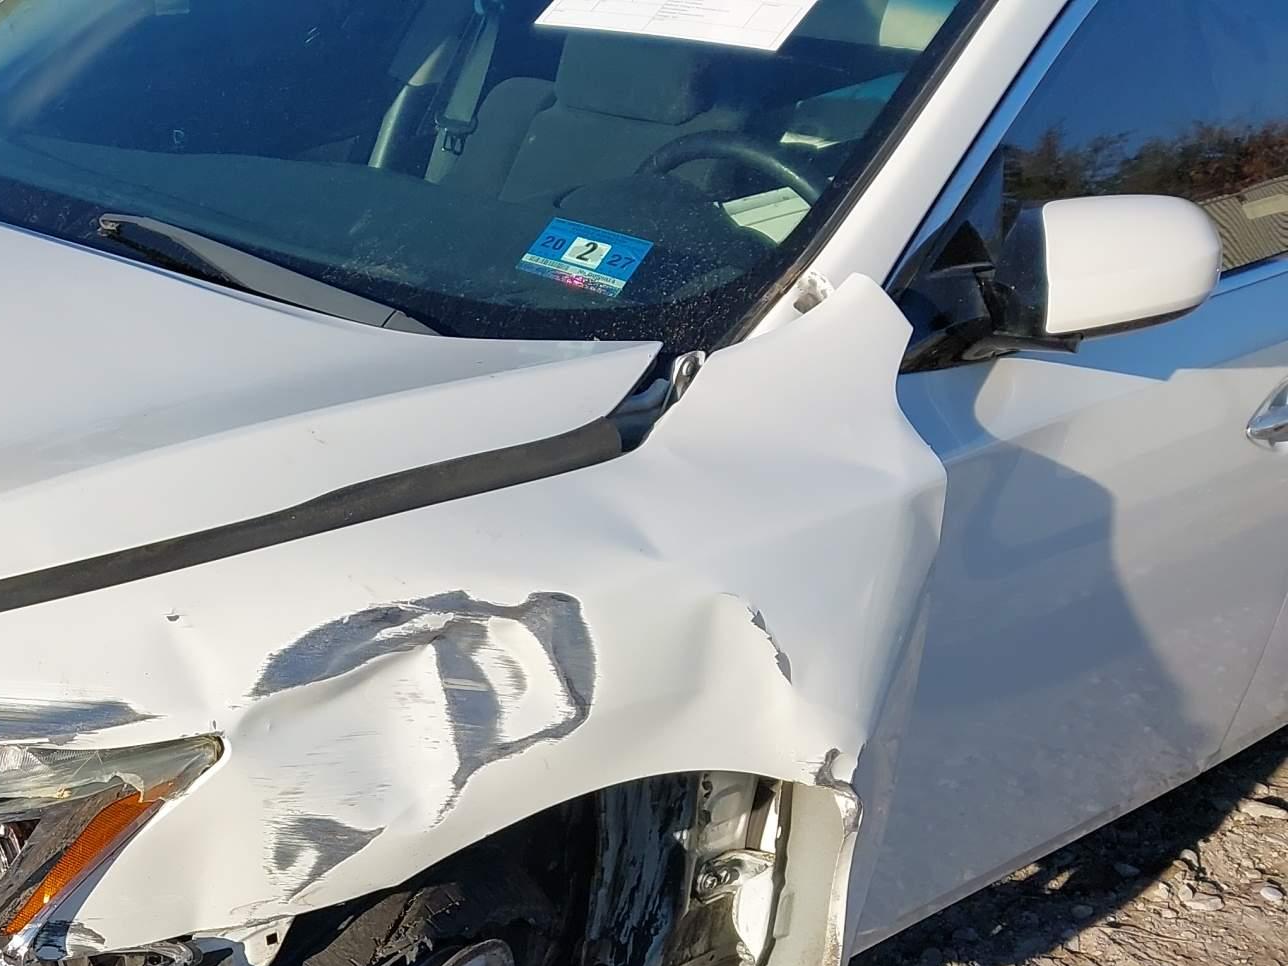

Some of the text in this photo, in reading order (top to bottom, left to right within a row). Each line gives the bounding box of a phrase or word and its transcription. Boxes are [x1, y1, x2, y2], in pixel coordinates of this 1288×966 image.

[542, 236, 636, 269] 20 2 27
